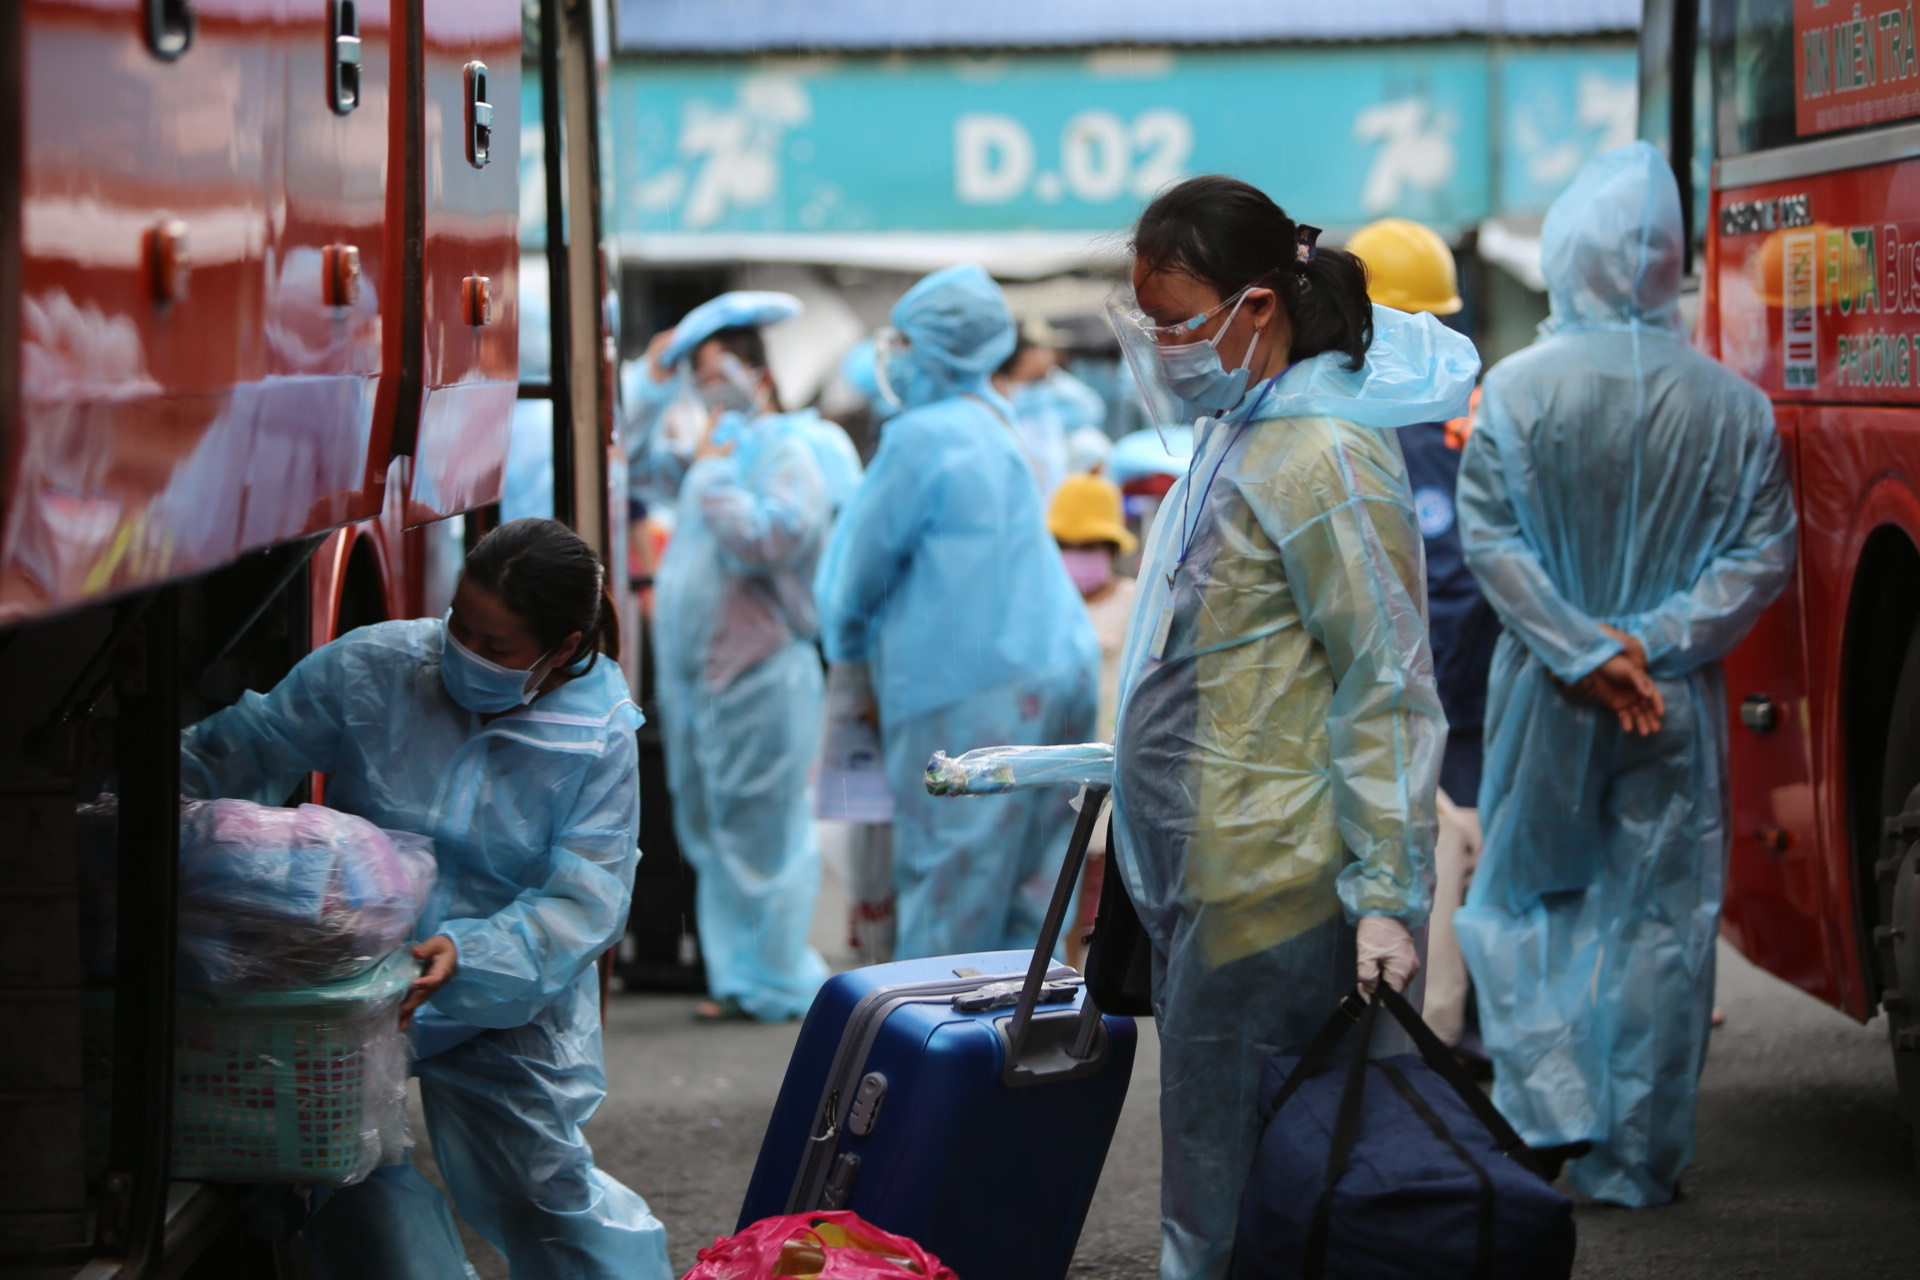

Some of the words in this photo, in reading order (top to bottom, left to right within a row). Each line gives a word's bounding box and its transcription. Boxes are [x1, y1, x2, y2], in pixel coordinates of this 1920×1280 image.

[1802, 26, 1831, 101] XIN
[954, 107, 1194, 204] D.02
[1825, 228, 1881, 316] FUTA
